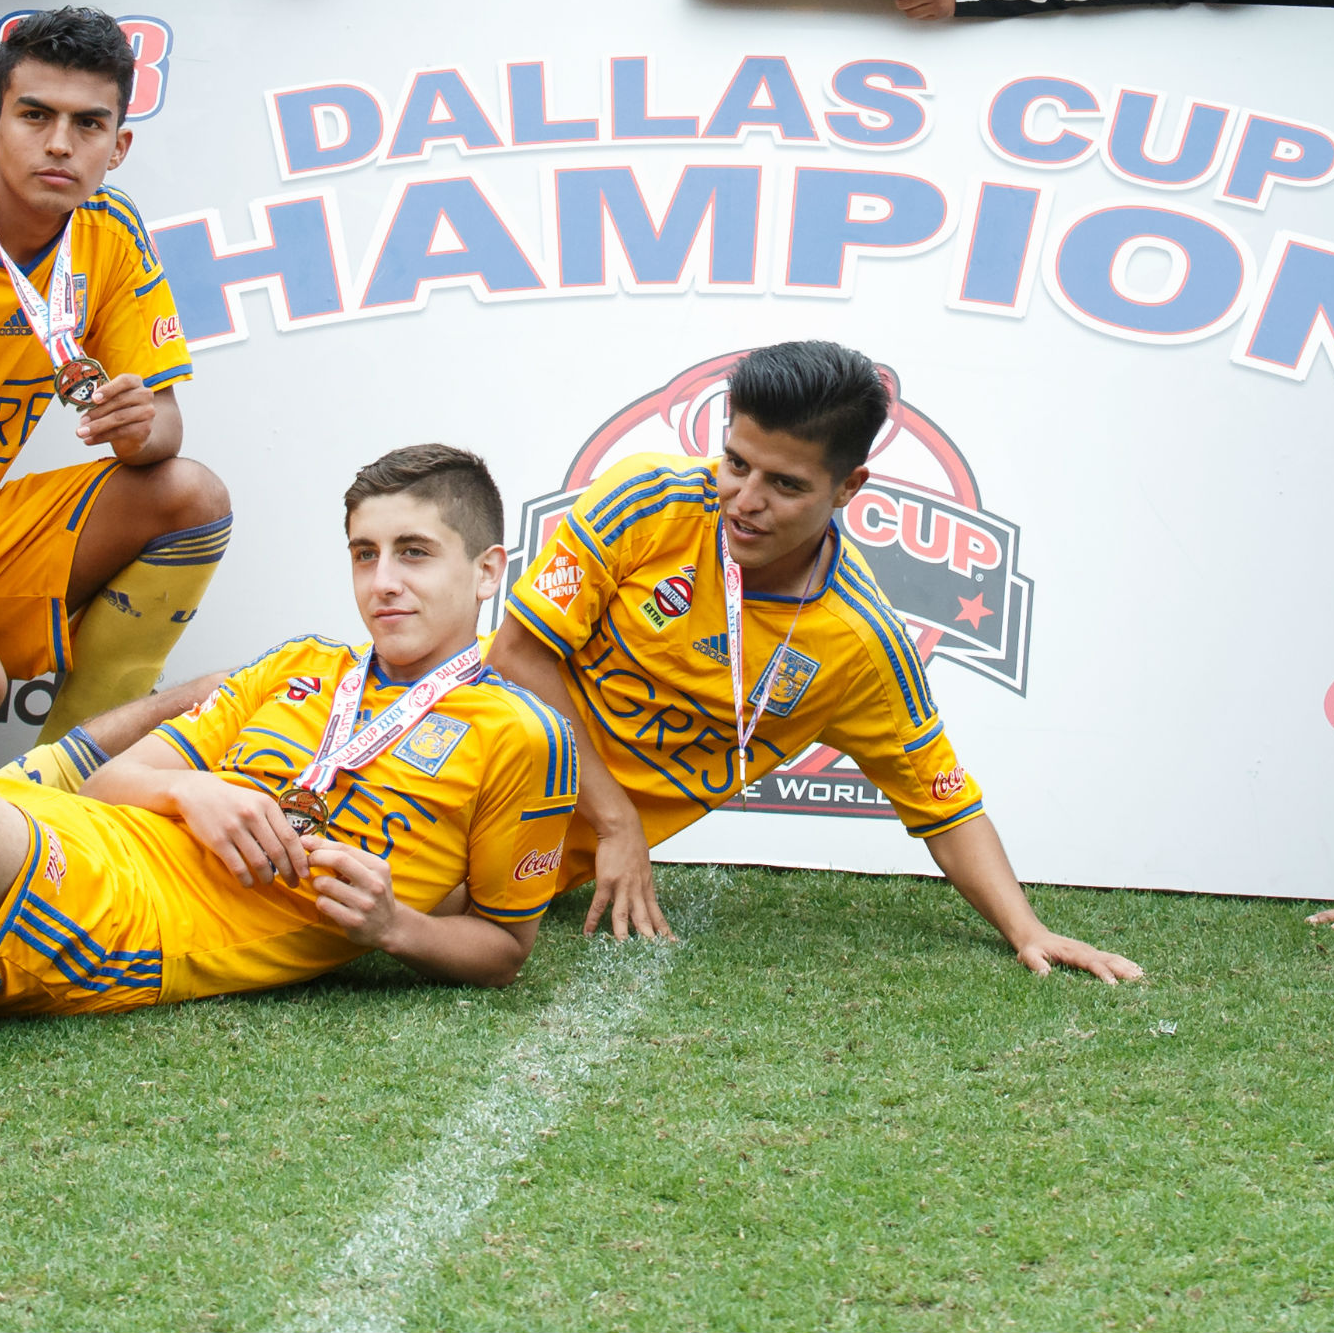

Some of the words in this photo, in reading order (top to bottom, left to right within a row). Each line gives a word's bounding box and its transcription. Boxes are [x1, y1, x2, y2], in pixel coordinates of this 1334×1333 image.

[274, 54, 930, 175] DALLAS
[841, 488, 1003, 578] CUP
[640, 600, 666, 628] EXTRA
[435, 656, 468, 682] DALLAS
[376, 707, 406, 732] XXXIX
